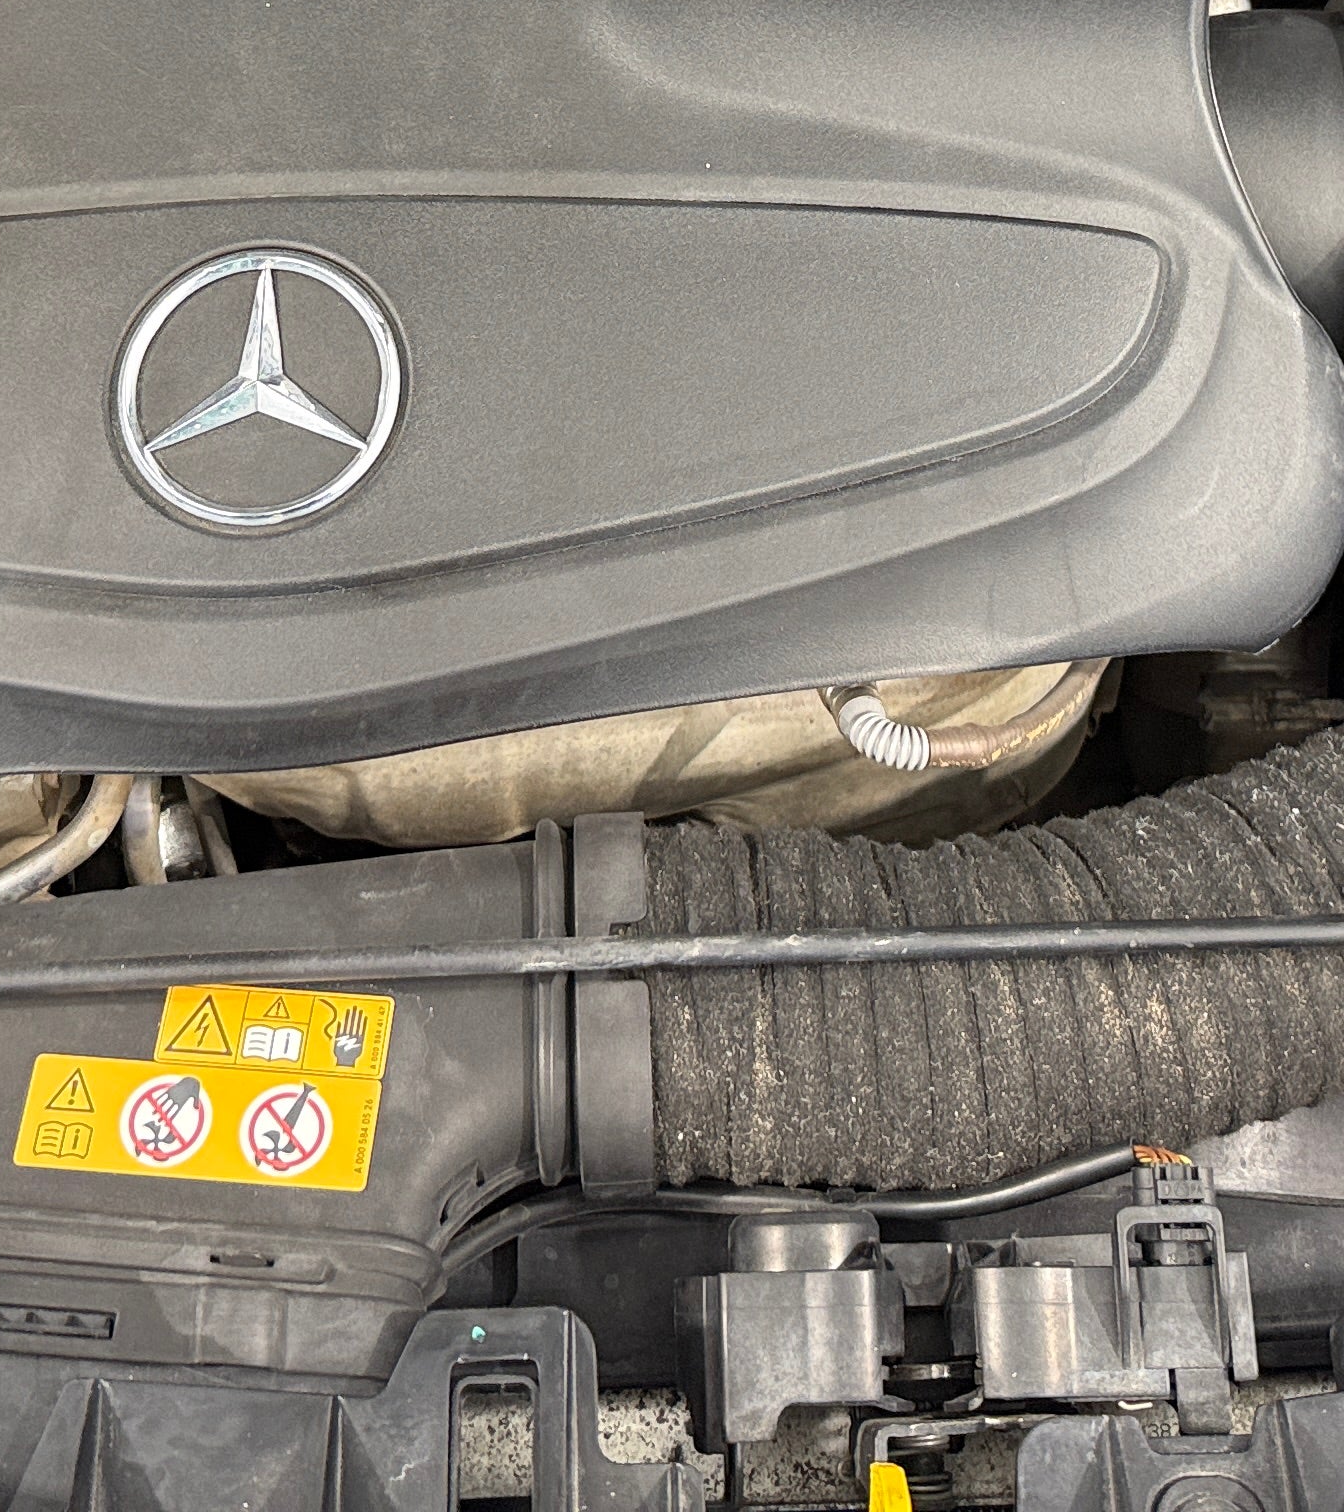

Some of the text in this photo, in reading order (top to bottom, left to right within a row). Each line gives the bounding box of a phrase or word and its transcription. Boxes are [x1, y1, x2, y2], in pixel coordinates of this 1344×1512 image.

[370, 1046, 379, 1062] 000
[363, 1098, 374, 1111] 26
[361, 1112, 371, 1125] 05
[358, 1126, 369, 1145] 584
[355, 1146, 366, 1165] 000
